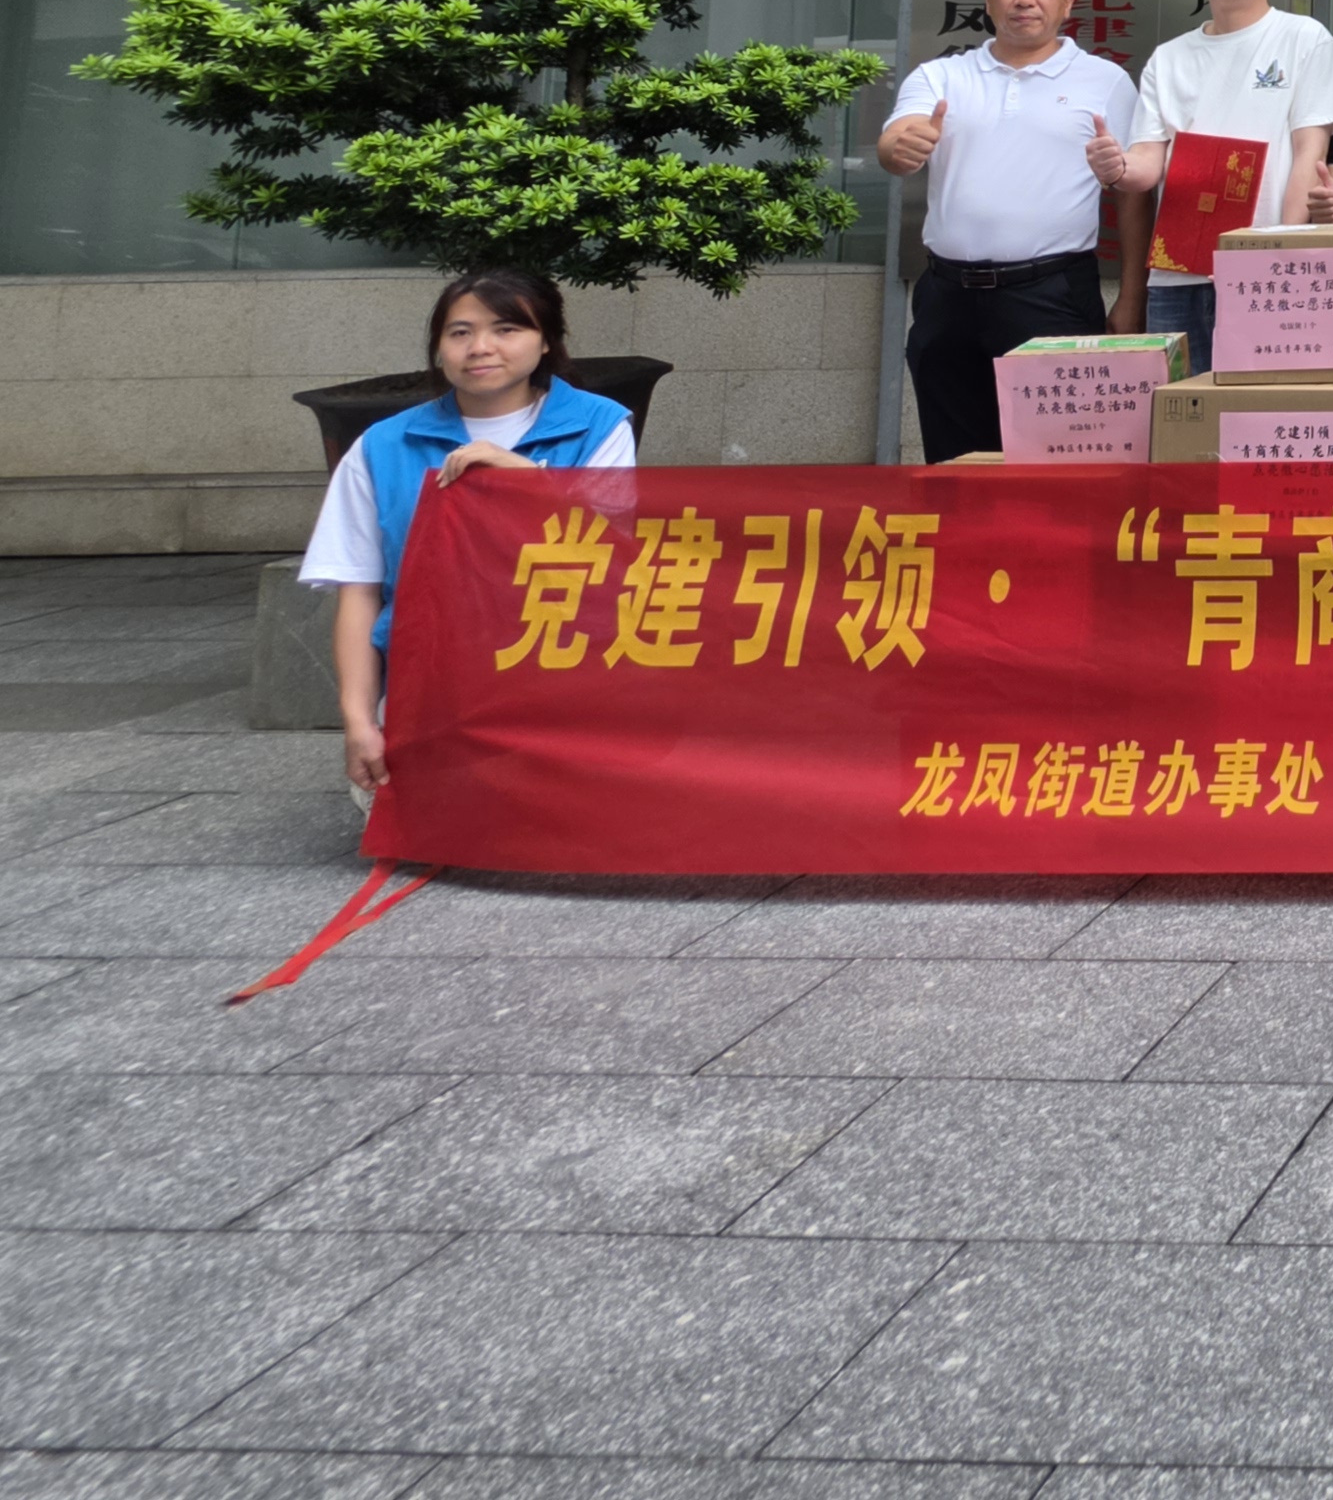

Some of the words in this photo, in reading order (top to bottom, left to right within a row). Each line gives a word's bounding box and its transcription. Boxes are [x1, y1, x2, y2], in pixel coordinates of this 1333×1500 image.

[1270, 261, 1327, 276] 党建引领
[1254, 343, 1323, 355] 海珠区青年商会
[1053, 365, 1111, 380] 党建引领
[1036, 400, 1137, 415] 点亮微心愿活动
[1274, 425, 1330, 440] 党建引领
[1047, 443, 1114, 454] 海珠区青年商会
[900, 740, 1325, 820] 龙凤街道办事处
